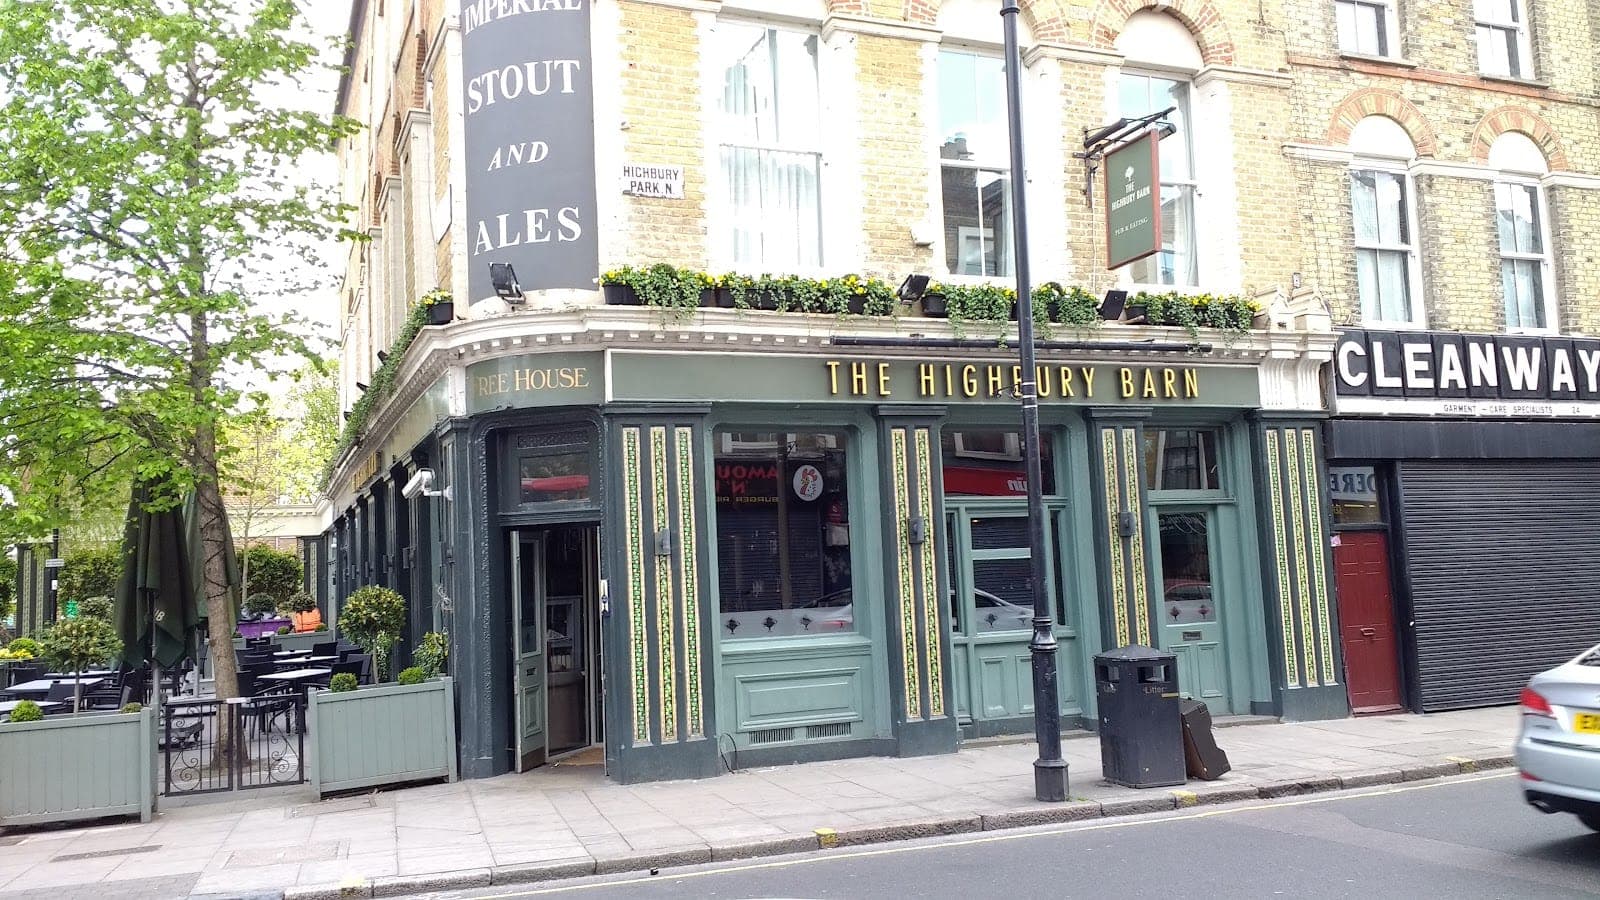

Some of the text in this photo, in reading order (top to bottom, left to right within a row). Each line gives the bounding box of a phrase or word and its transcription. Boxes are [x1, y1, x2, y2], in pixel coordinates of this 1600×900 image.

[468, 60, 580, 114] STOUT
[487, 141, 549, 171] AND
[474, 207, 582, 256] ALES
[475, 367, 589, 397] REE HOUSE
[826, 362, 892, 395] THE
[1120, 367, 1199, 398] BARN
[1443, 404, 1476, 412] GARMENT
[1489, 405, 1507, 414] CARE
[1513, 405, 1553, 414] SPECIALISTS
